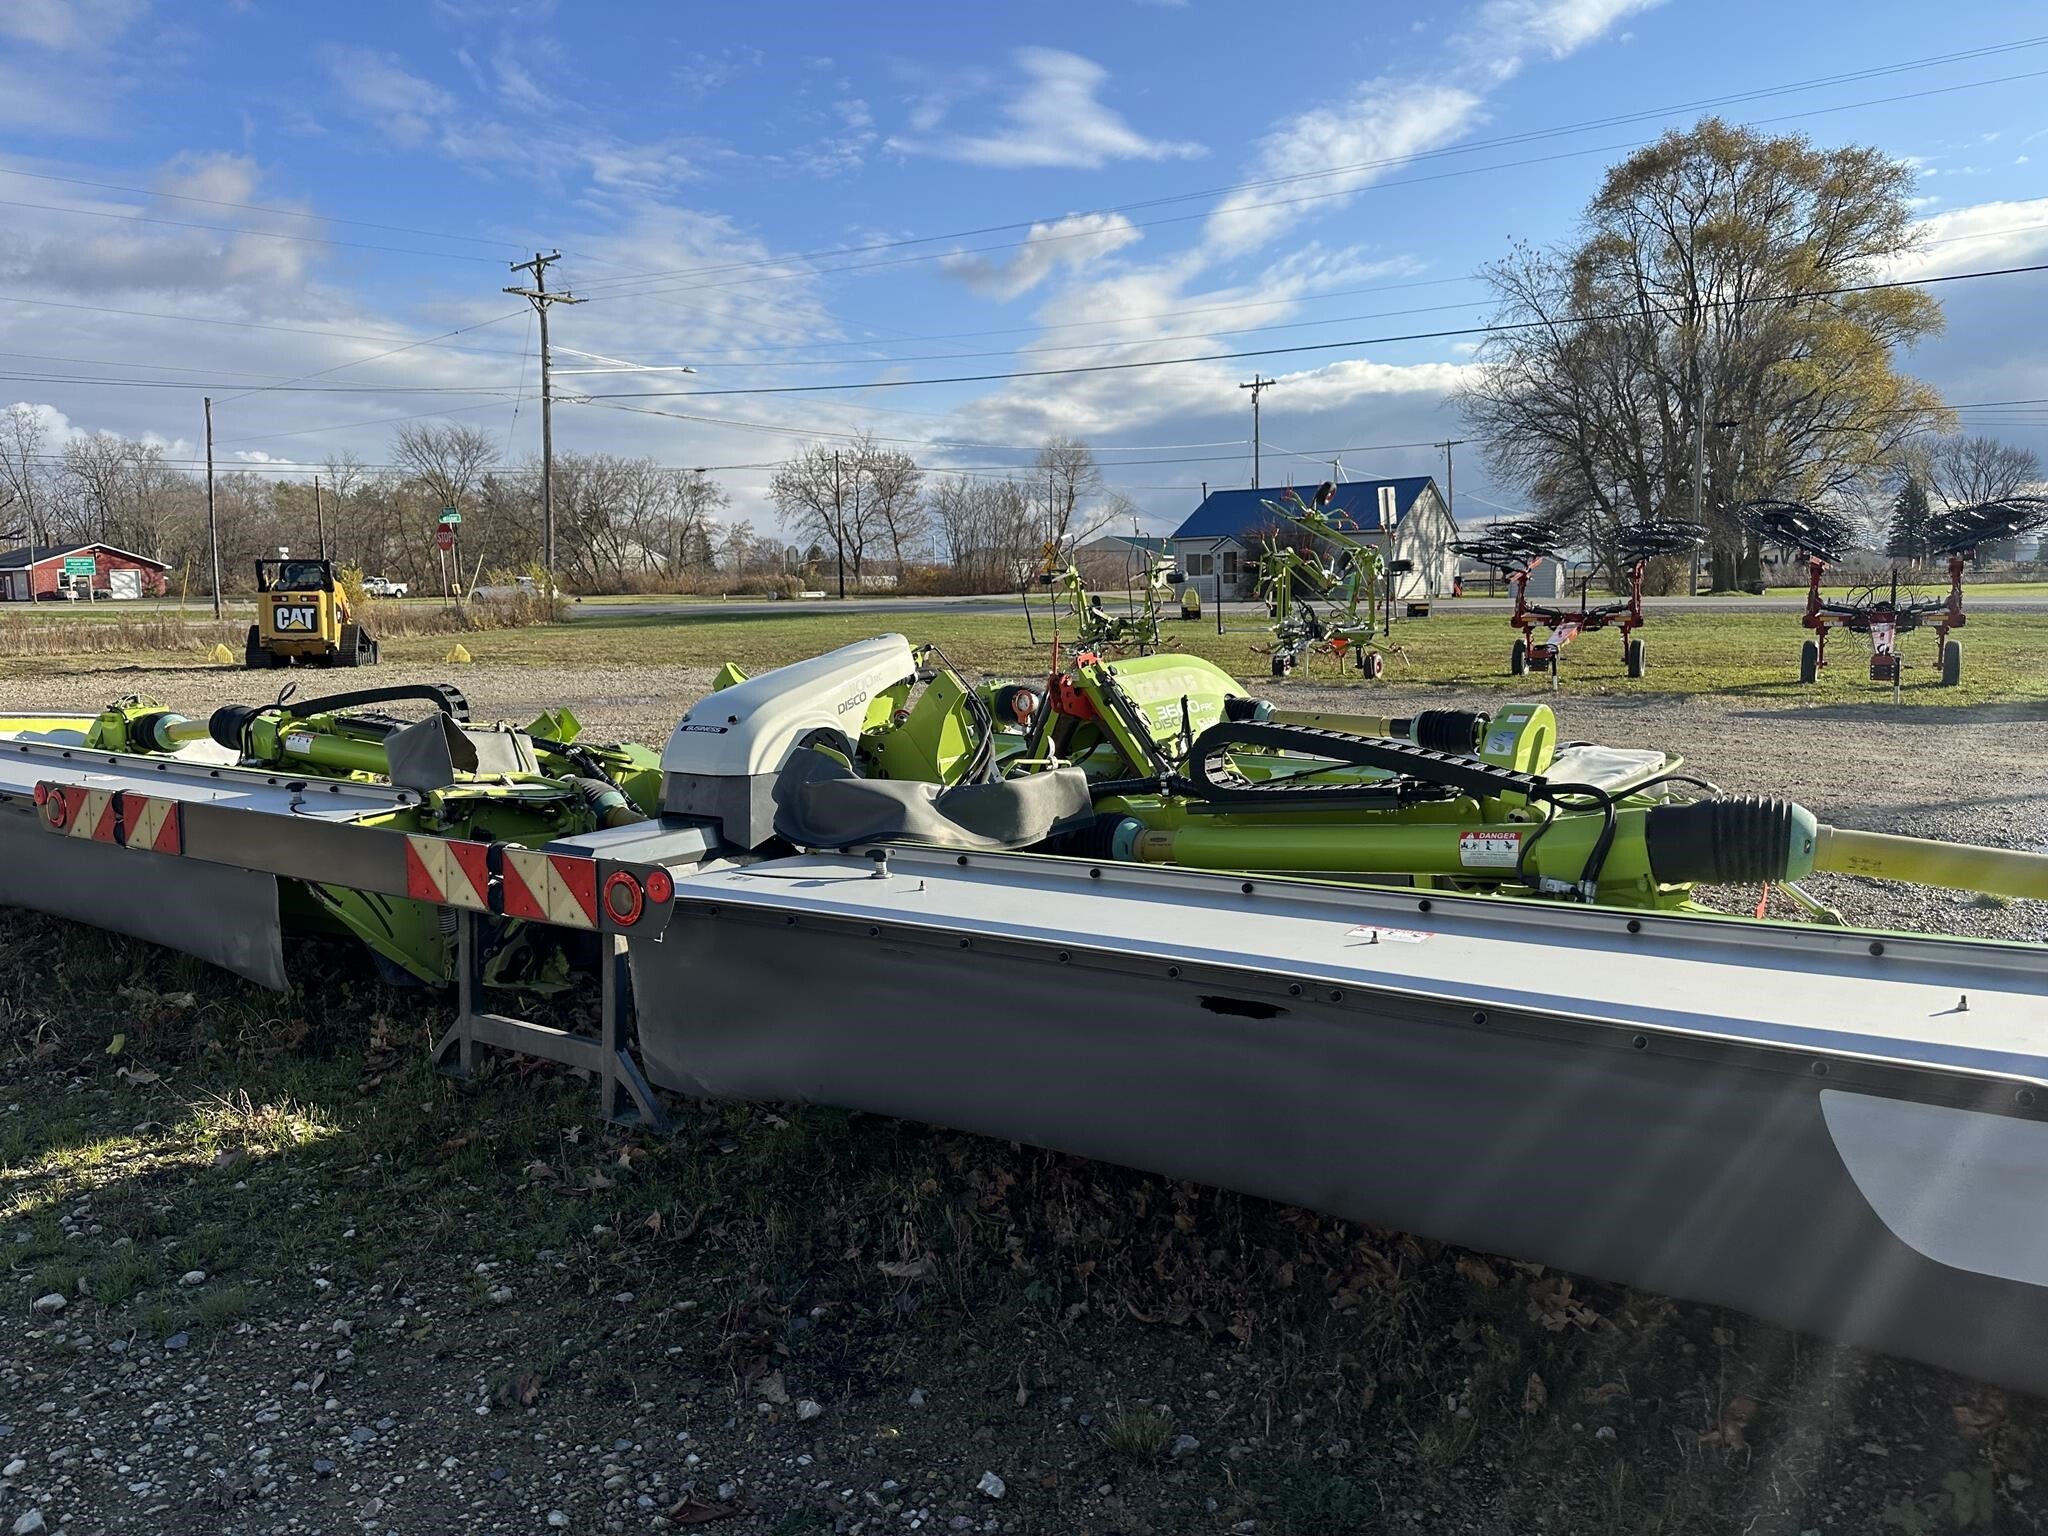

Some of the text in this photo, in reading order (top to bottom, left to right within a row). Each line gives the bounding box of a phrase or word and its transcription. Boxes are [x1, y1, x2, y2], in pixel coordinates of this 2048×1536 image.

[437, 531, 452, 542] STOP
[276, 607, 315, 630] CAT
[837, 691, 867, 715] DISCO
[1153, 715, 1182, 731] DISC
